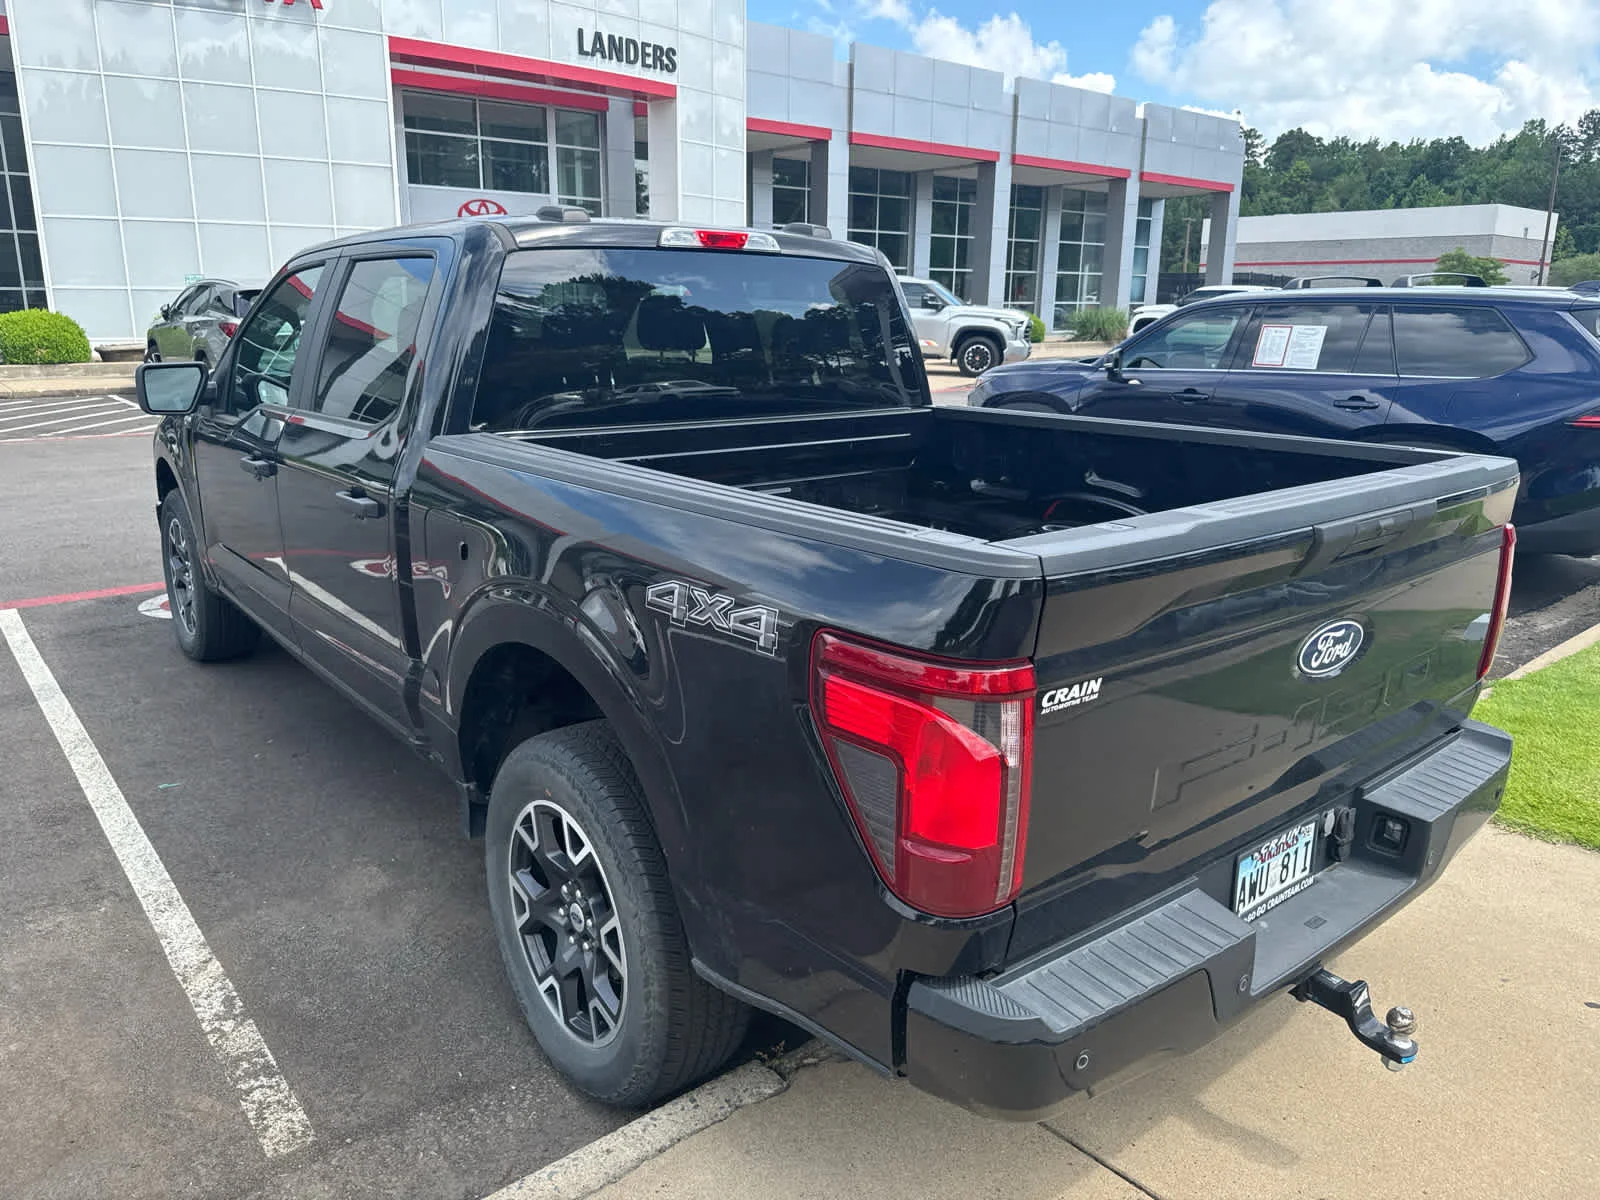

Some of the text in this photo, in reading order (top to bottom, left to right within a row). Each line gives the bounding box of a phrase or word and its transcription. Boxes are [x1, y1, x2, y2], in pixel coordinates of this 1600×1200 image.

[578, 28, 677, 73] LANDERS
[1311, 628, 1354, 668] Ford
[1042, 677, 1103, 708] CRAIN
[1082, 693, 1099, 703] TEAM
[1238, 861, 1270, 911] AWU
